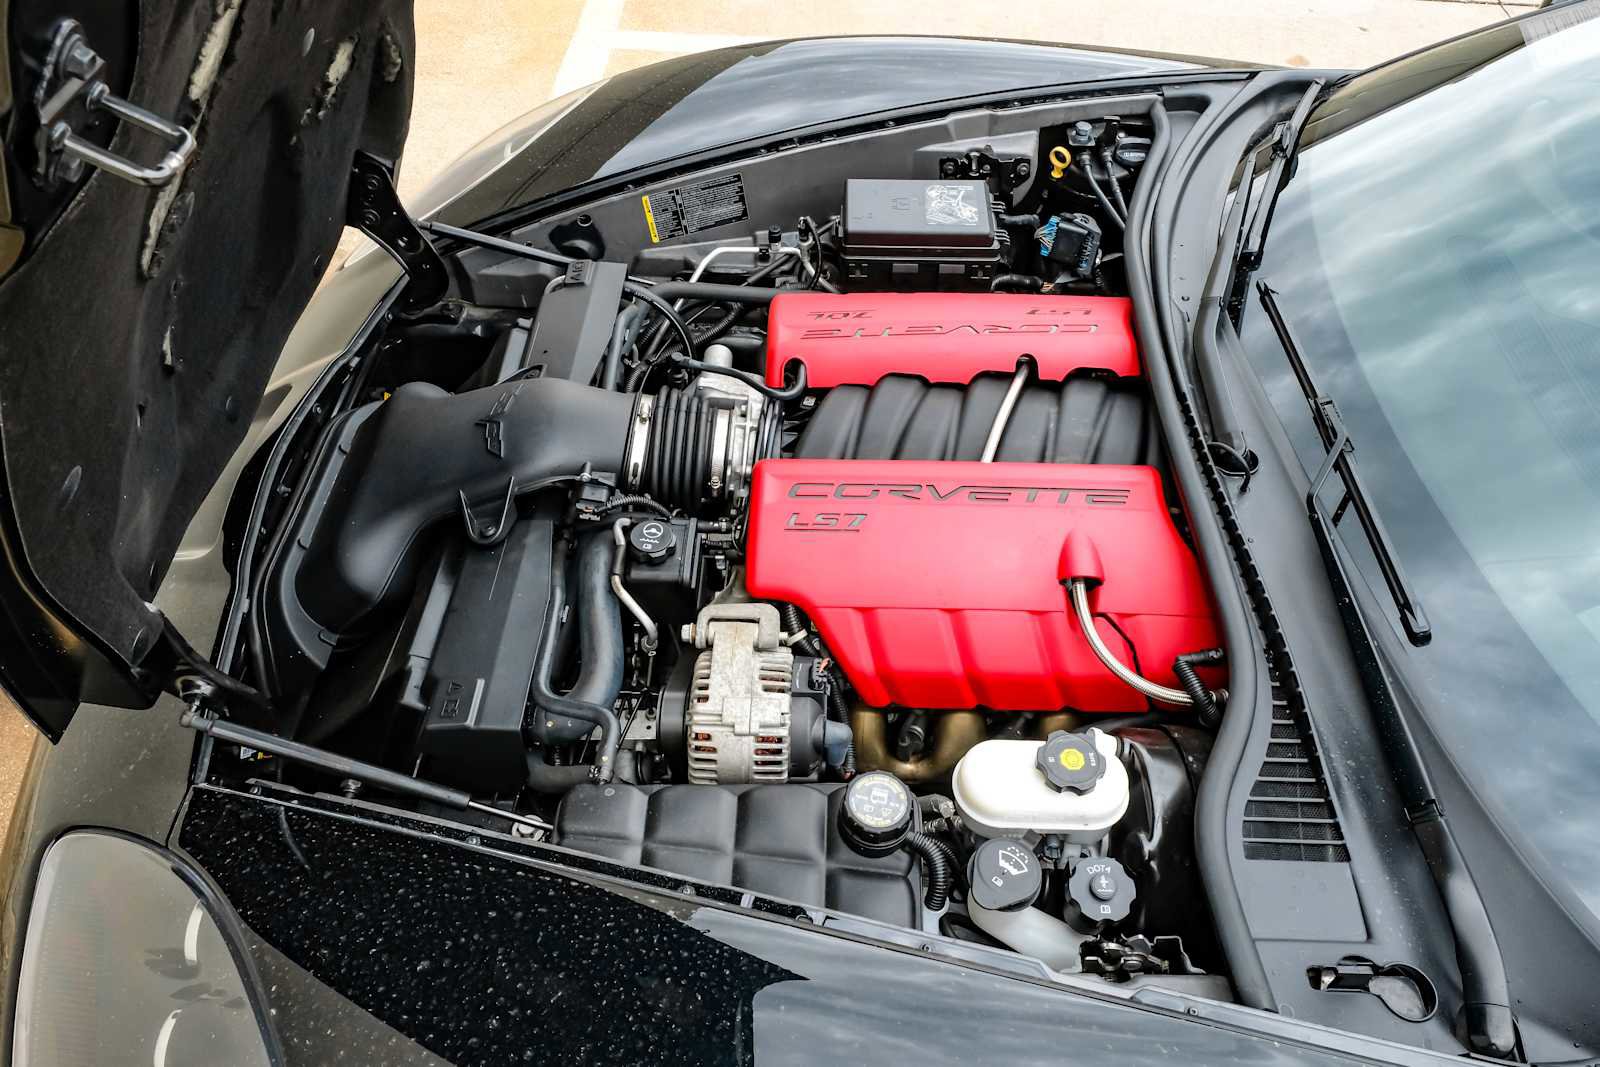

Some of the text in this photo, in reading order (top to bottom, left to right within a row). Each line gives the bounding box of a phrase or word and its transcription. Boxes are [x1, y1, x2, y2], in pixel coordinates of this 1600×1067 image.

[800, 324, 1099, 339] CORVETTE
[787, 482, 1130, 504] CORVETTE
[786, 512, 867, 529] LS7
